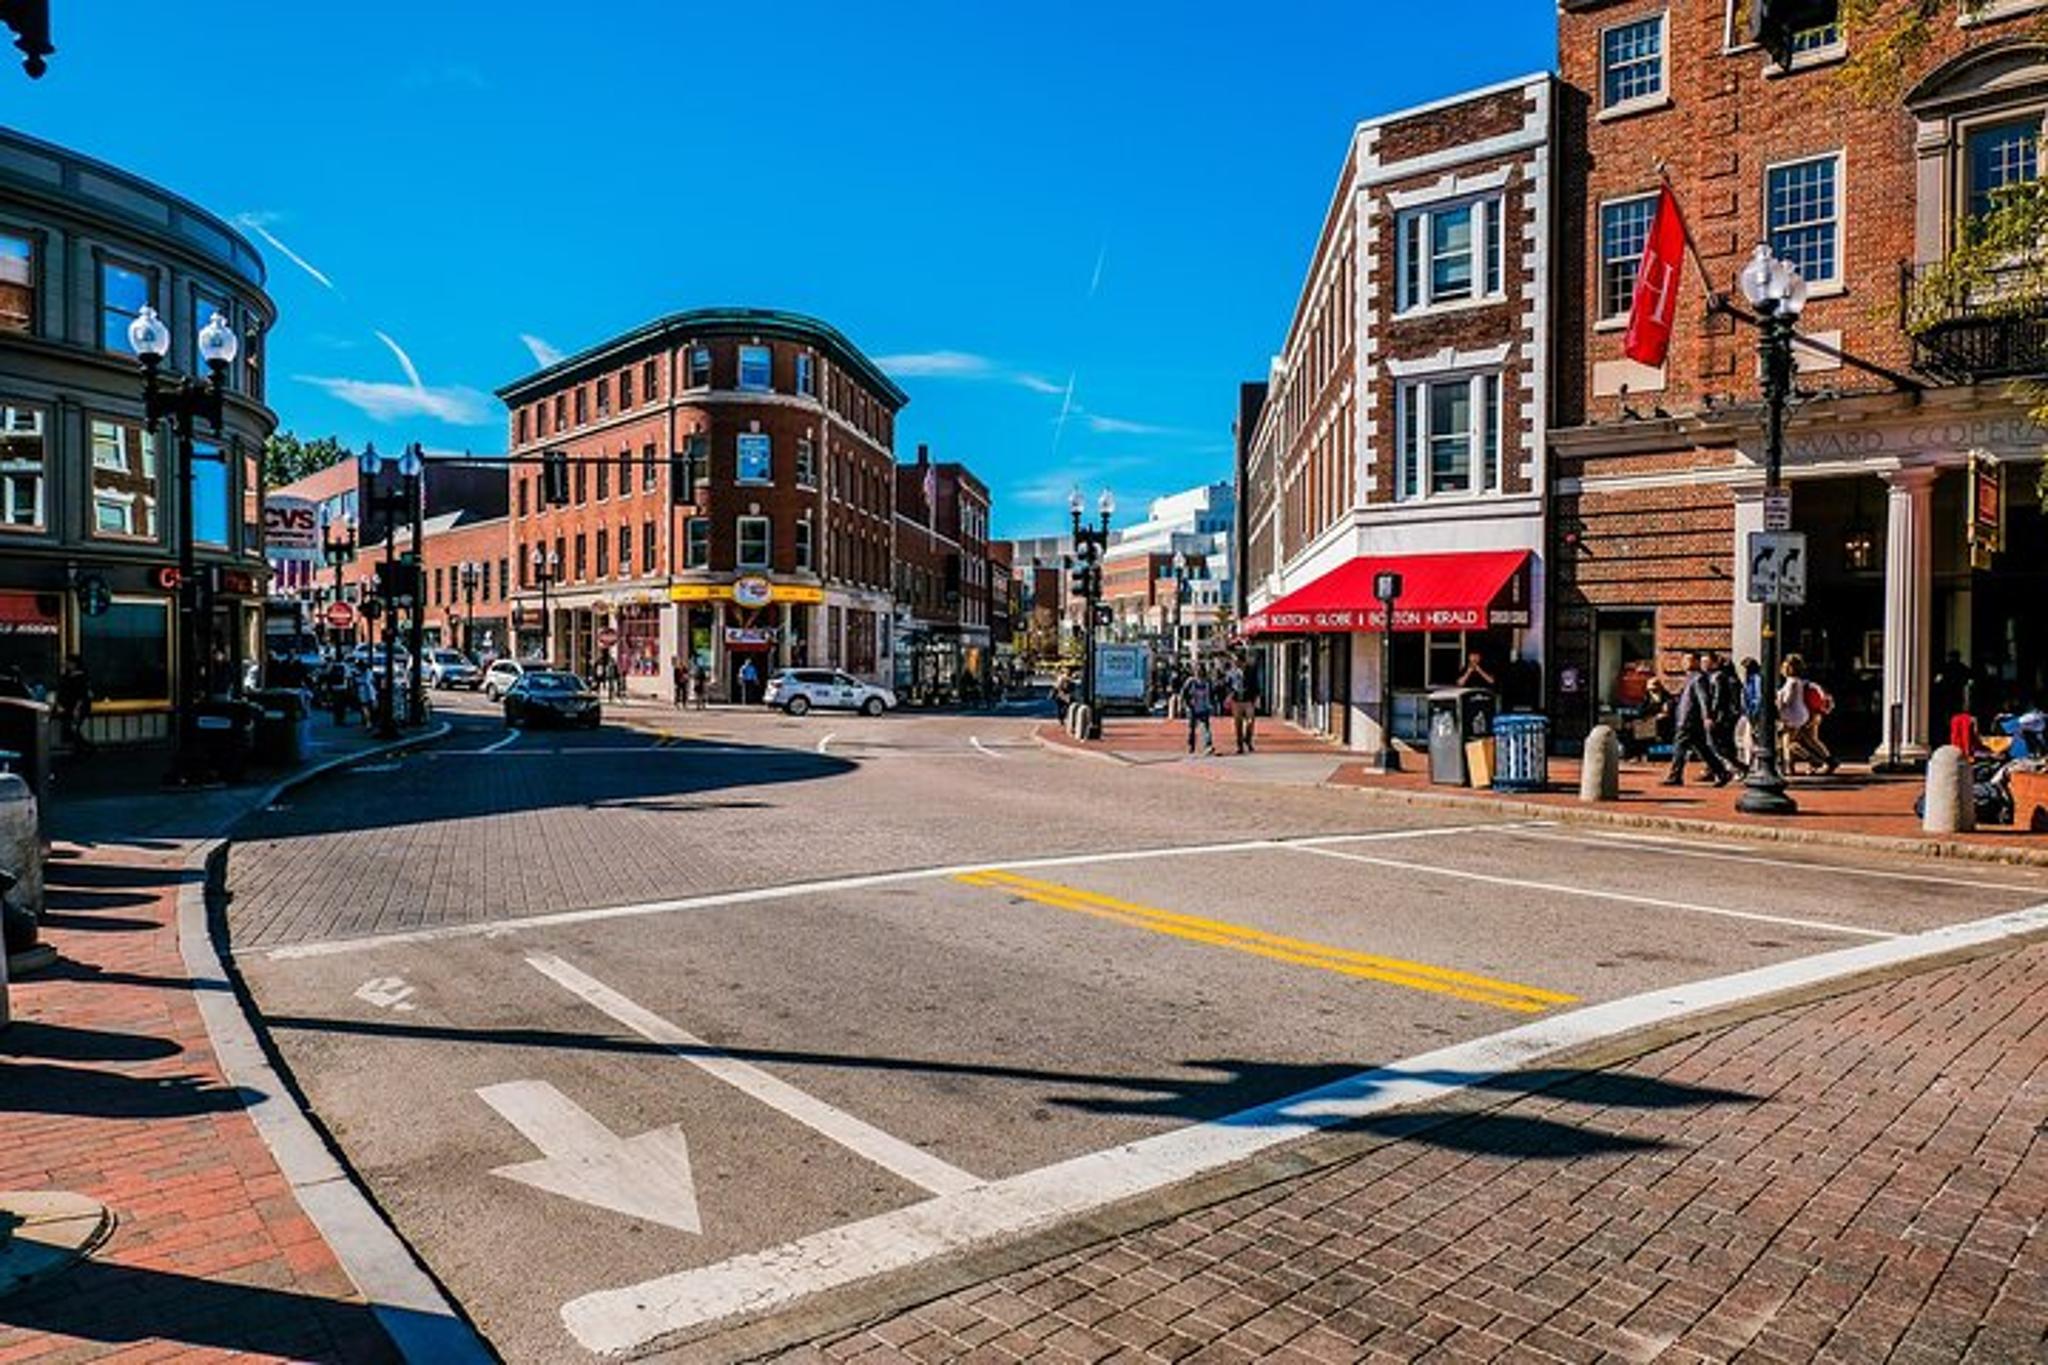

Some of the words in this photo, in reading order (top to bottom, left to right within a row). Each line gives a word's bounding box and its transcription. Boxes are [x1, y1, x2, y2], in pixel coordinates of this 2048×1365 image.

[264, 508, 315, 530] CVS
[1369, 610, 1421, 626] BOTON
[1425, 610, 1478, 625] HERALD
